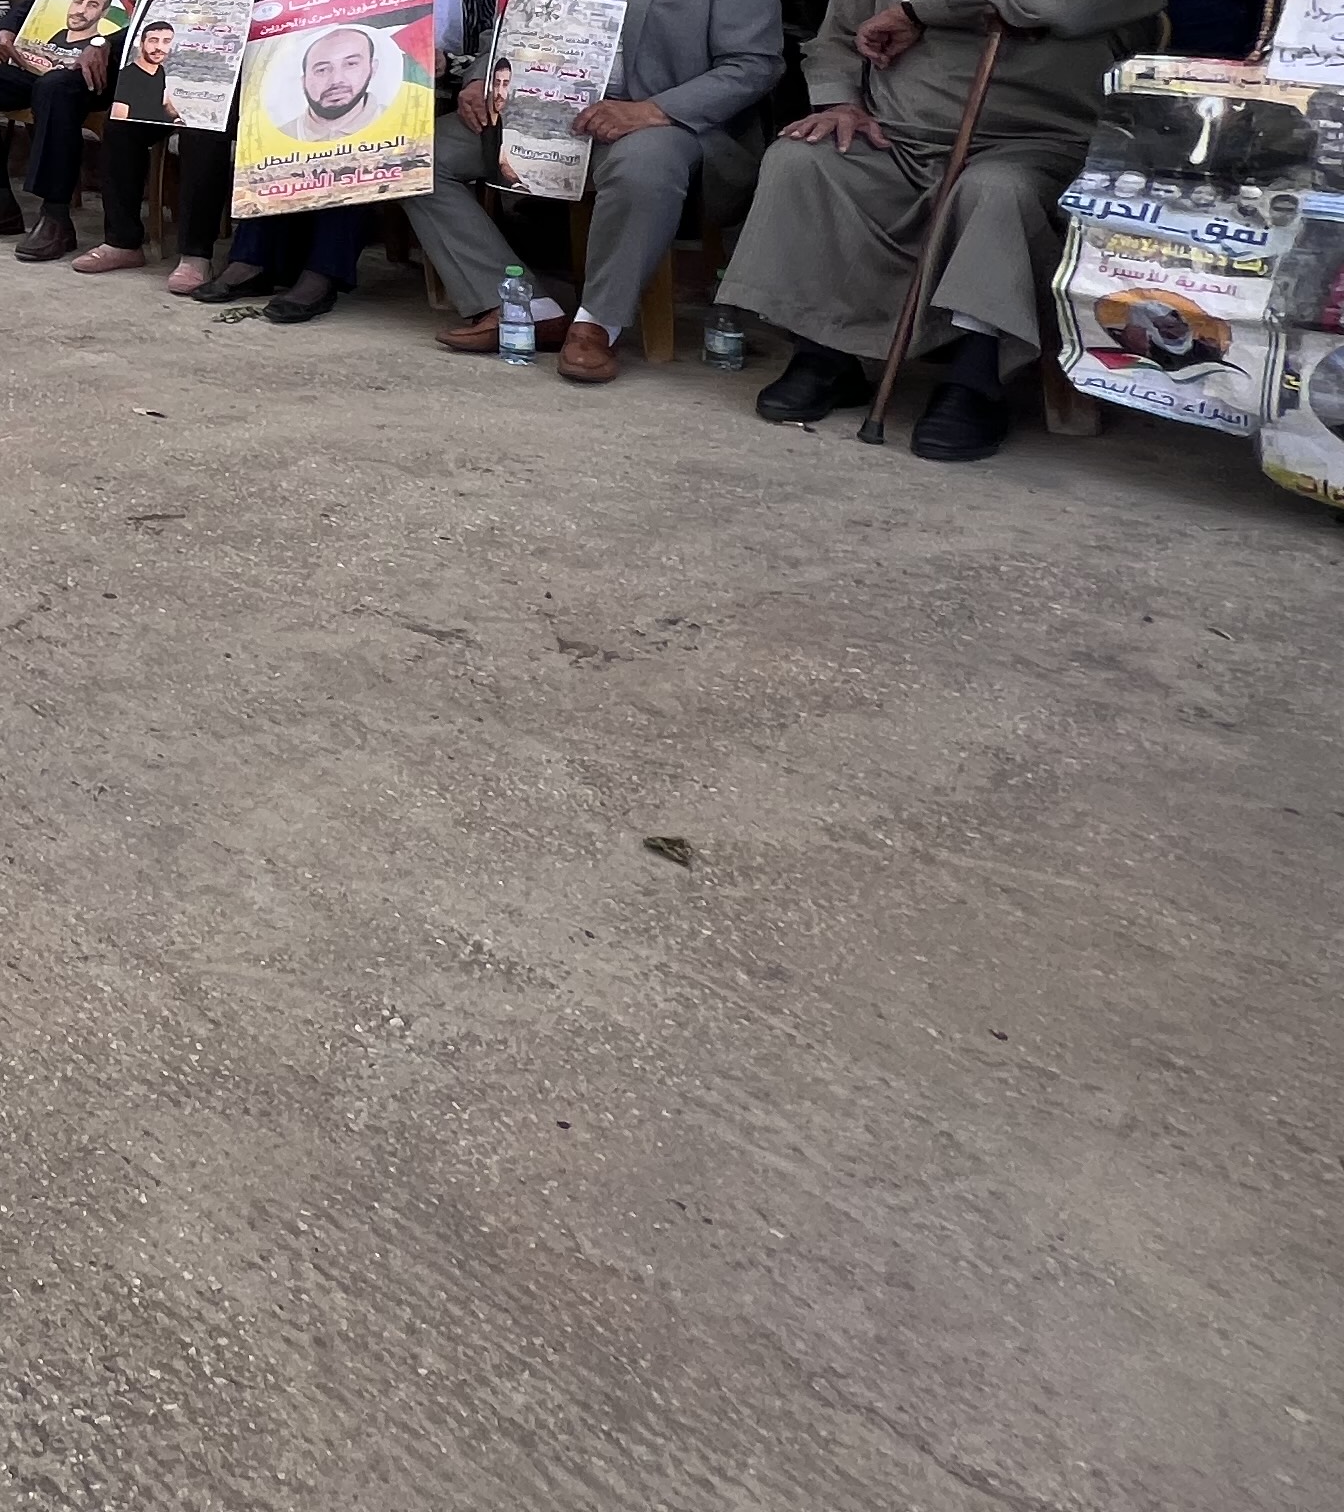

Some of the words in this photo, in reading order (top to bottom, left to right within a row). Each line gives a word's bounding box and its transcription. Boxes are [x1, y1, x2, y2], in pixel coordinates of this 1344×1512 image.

[358, 136, 405, 155] الحرية
[257, 151, 300, 170] البطل
[340, 166, 404, 186] عماد
[1175, 276, 1237, 296] الحرية
